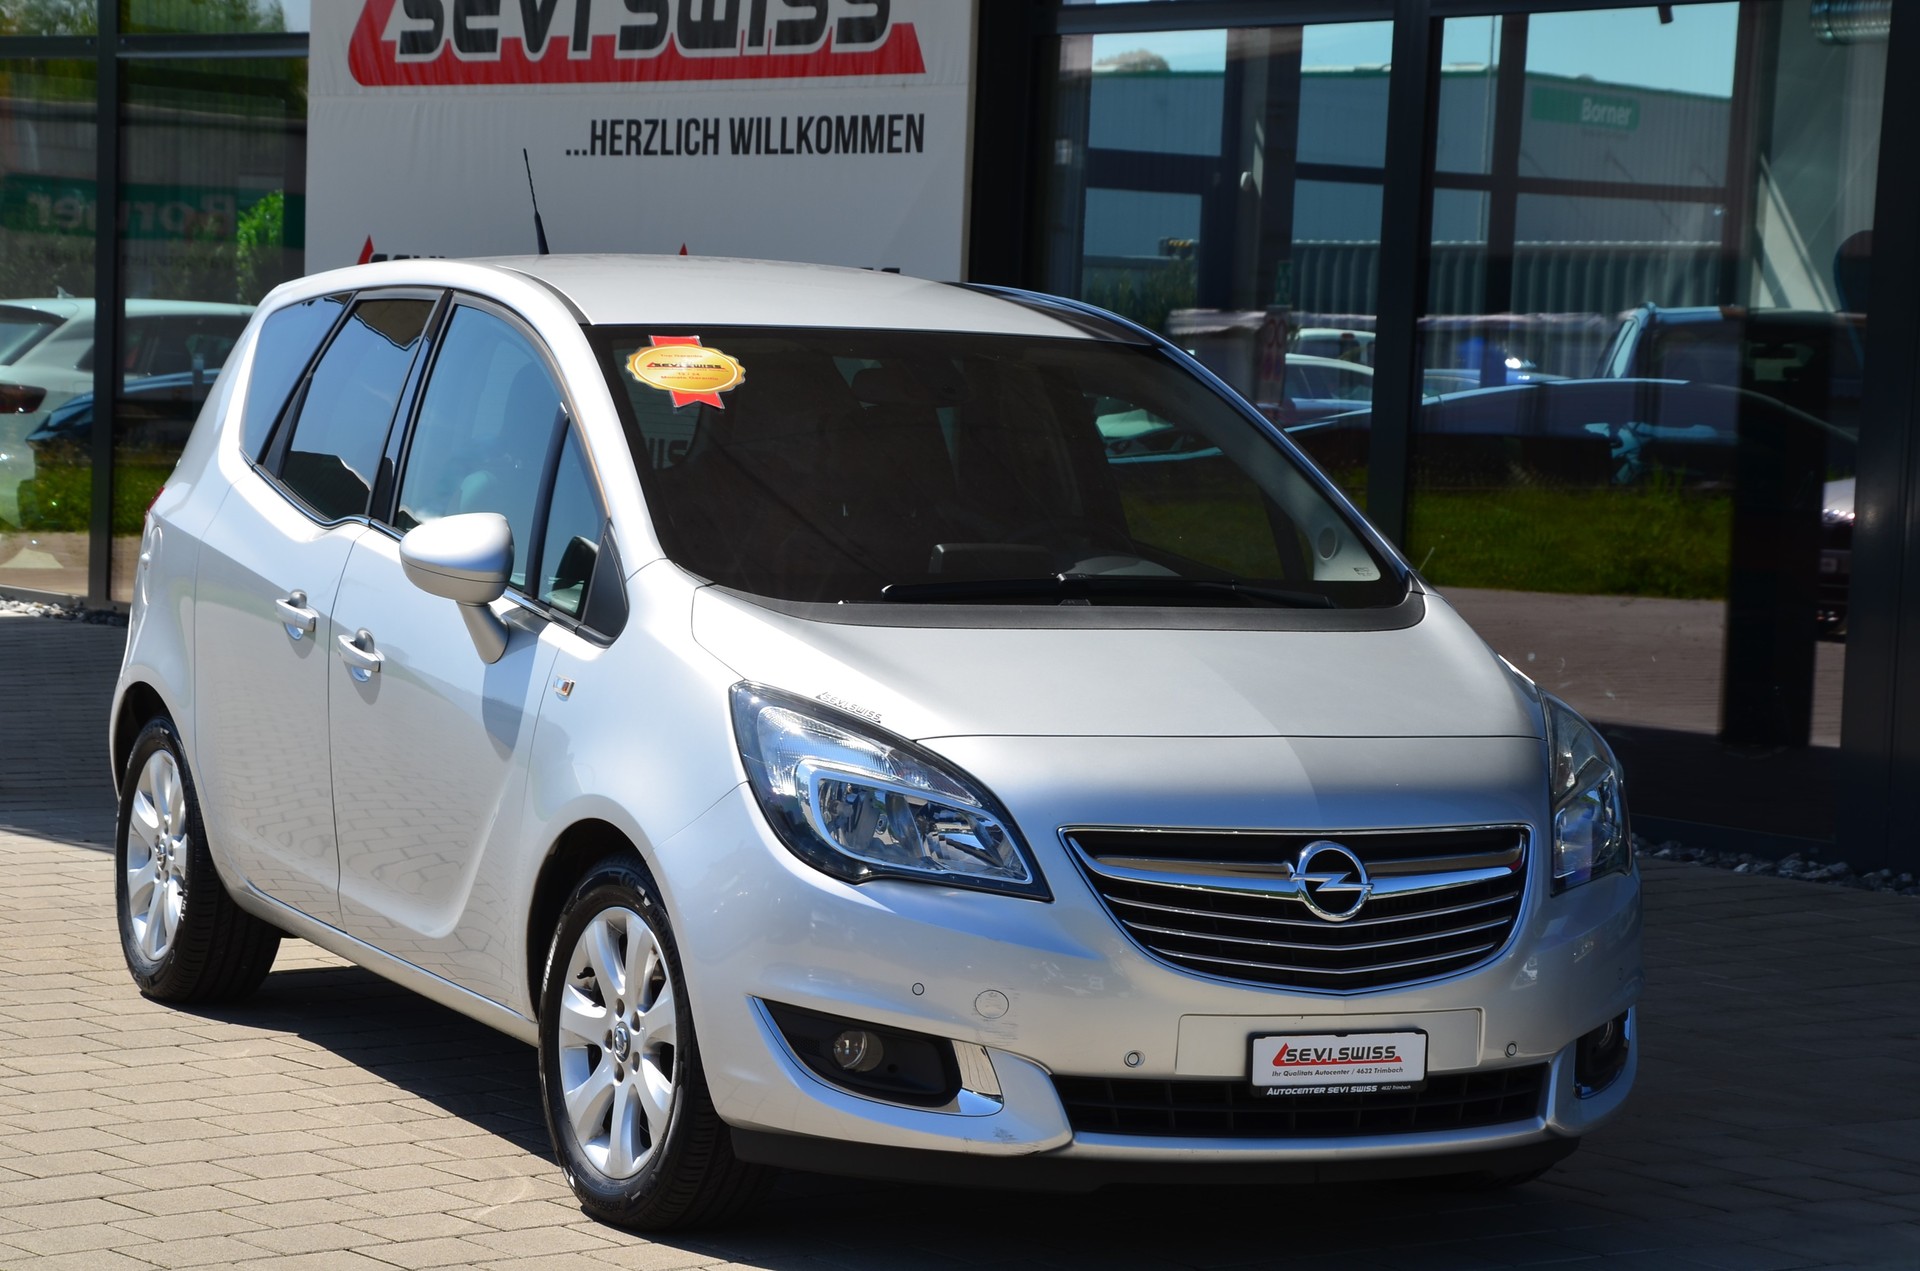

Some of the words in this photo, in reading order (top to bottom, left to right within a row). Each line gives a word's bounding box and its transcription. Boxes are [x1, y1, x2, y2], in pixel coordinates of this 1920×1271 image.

[399, 0, 592, 55] SEVI
[618, 0, 891, 51] SWISS
[1581, 97, 1632, 126] Borner
[729, 113, 925, 155] WILLKOMMEN
[1285, 1047, 1333, 1062] SEVI
[1337, 1045, 1396, 1061] SWISS
[1315, 1068, 1350, 1076] Autocenter
[1356, 1067, 1372, 1075] 4632
[1374, 1066, 1403, 1074] Trimbach
[1266, 1086, 1326, 1096] AUTOCENTER
[1327, 1086, 1350, 1094] SEVI
[1350, 1085, 1378, 1093] SWISS
